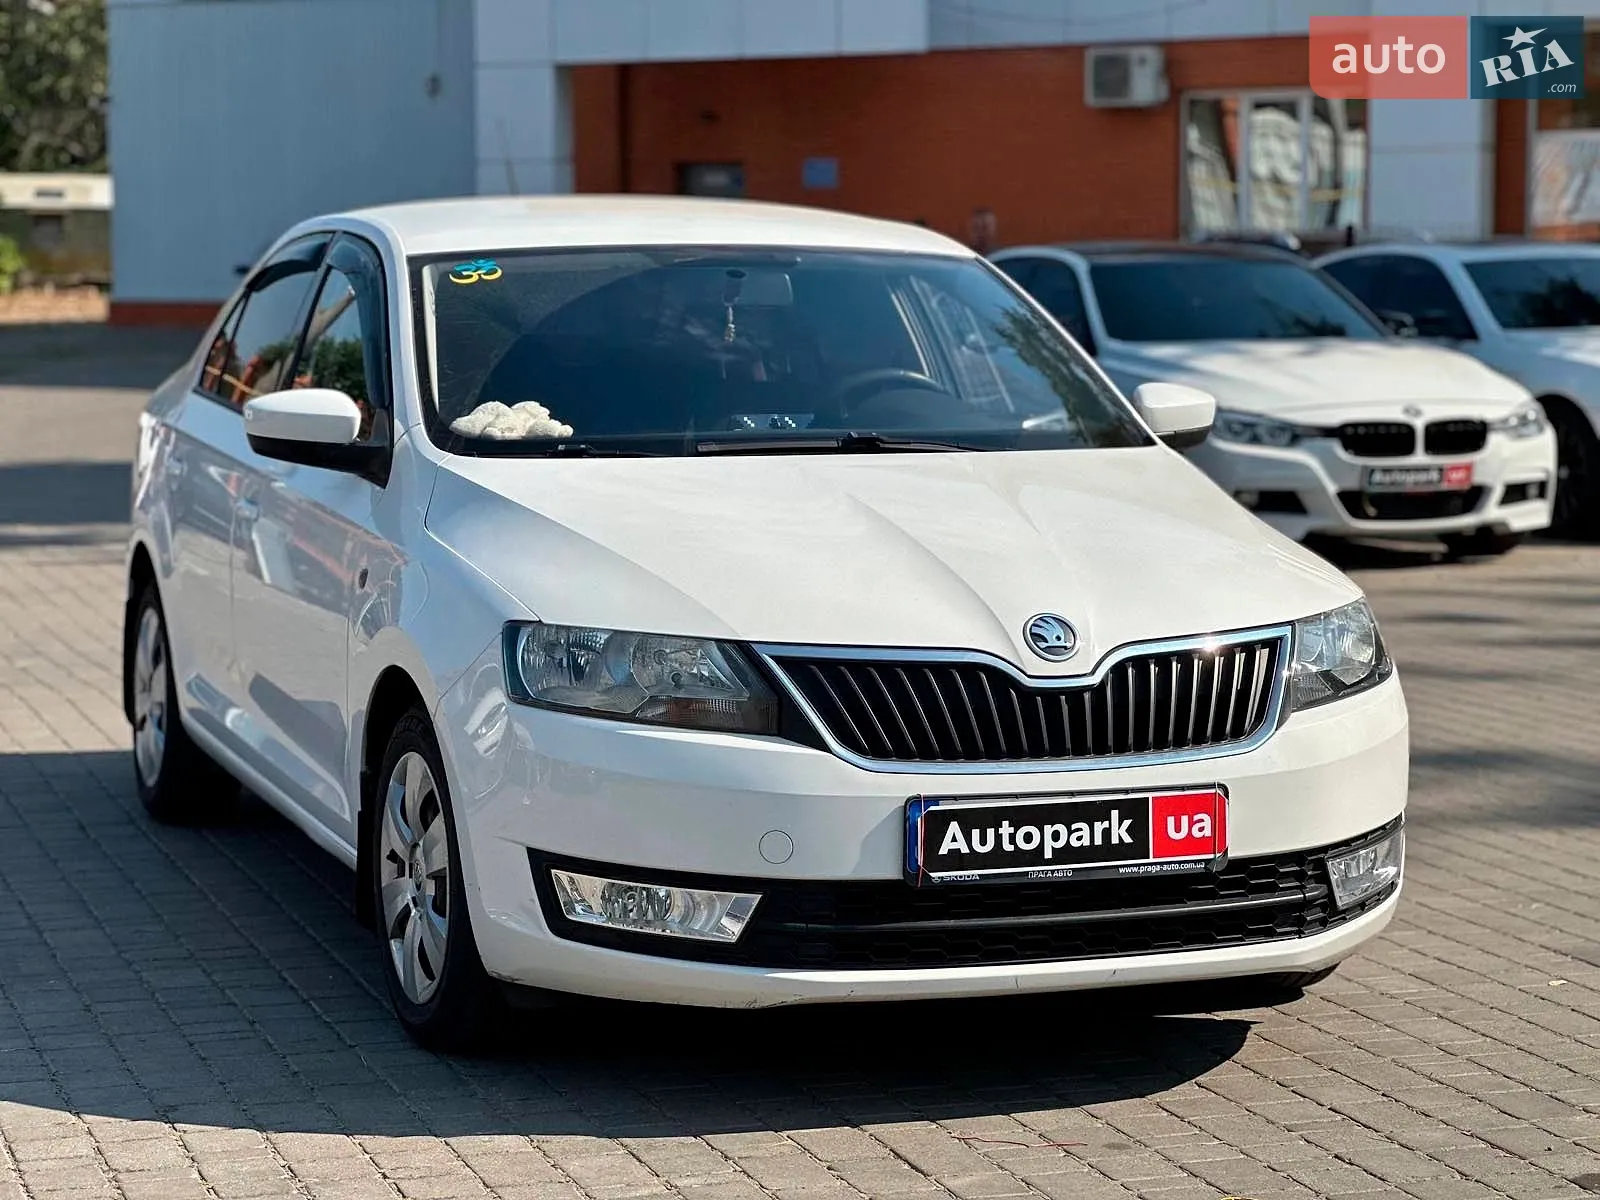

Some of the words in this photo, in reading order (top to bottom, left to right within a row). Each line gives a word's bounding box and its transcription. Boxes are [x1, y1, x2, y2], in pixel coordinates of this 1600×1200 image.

[938, 809, 1134, 859] Autopark
[1167, 812, 1212, 840] ua
[1028, 870, 1052, 879] ПРАГА
[1053, 869, 1073, 877] АВТО
[1118, 861, 1205, 874] www.praga-auto.com.ua
